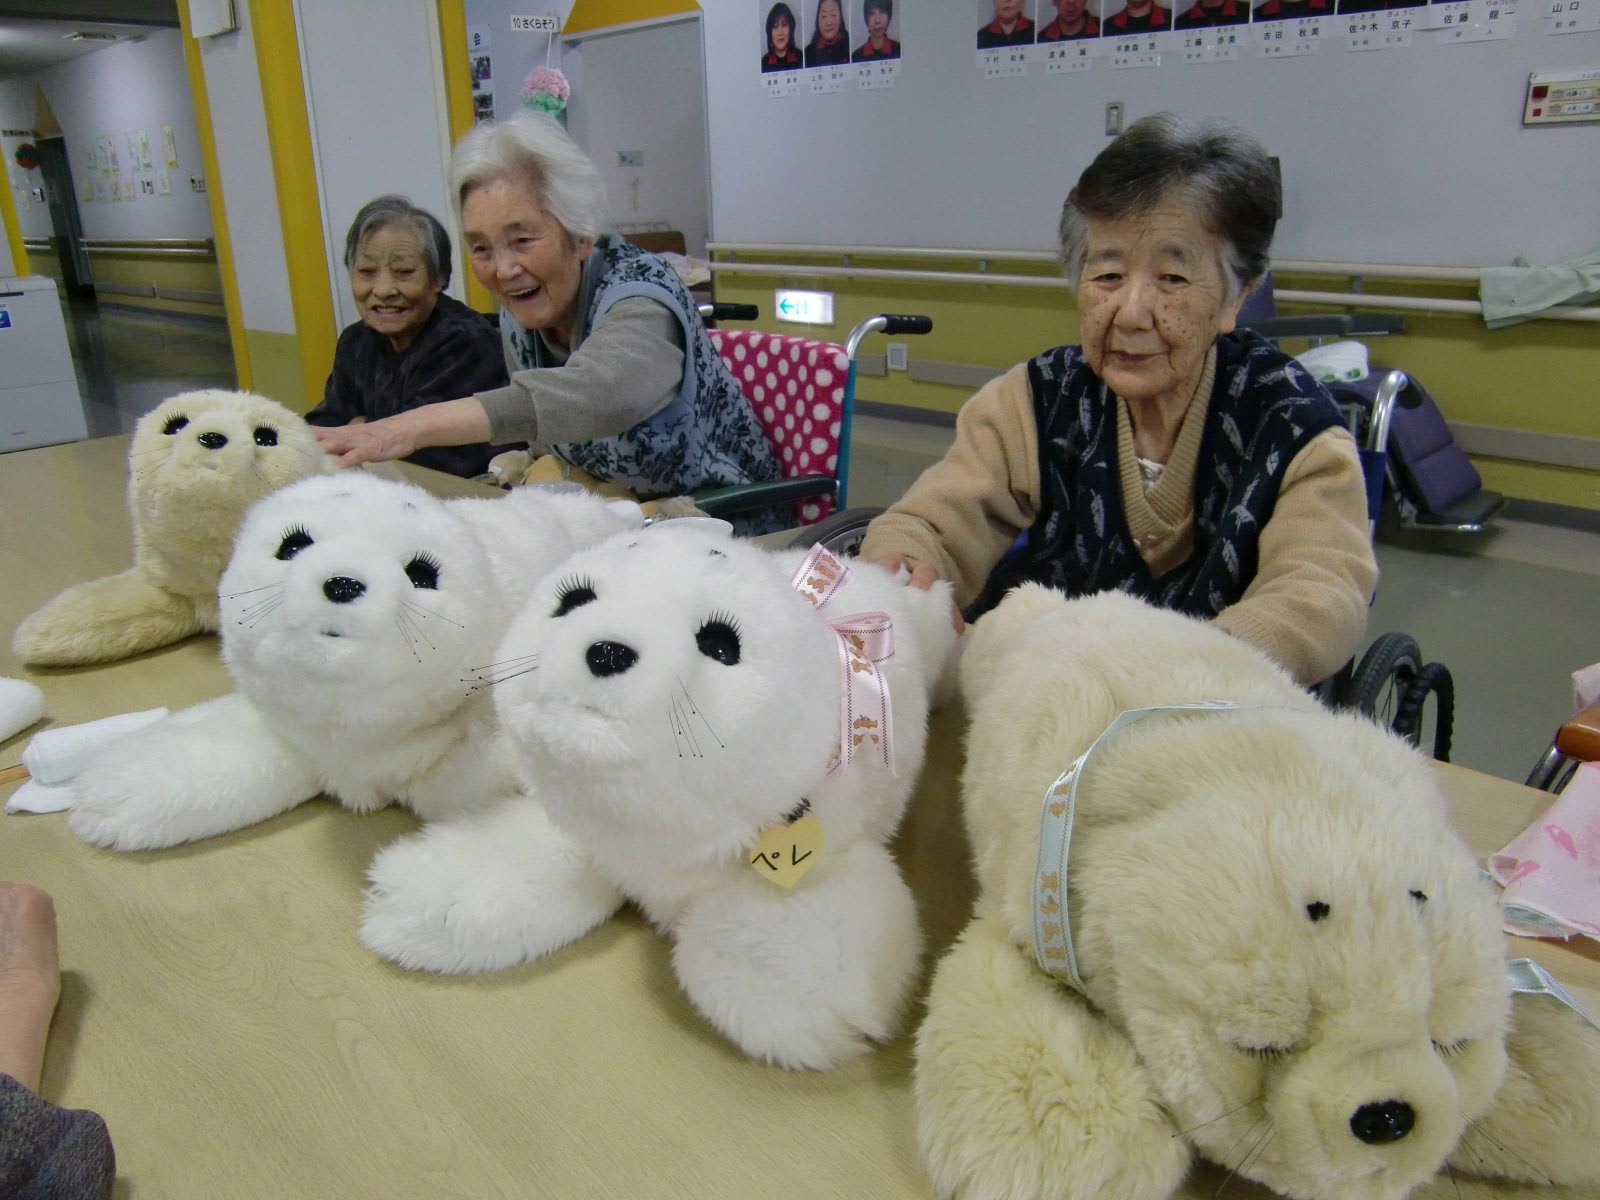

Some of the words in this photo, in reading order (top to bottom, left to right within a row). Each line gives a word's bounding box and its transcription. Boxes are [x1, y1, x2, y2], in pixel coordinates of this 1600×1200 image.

[1552, 1, 1580, 13] 山口
[1349, 24, 1379, 34] 佐々木
[1391, 19, 1412, 30] 京子
[1263, 31, 1283, 41] 吉田
